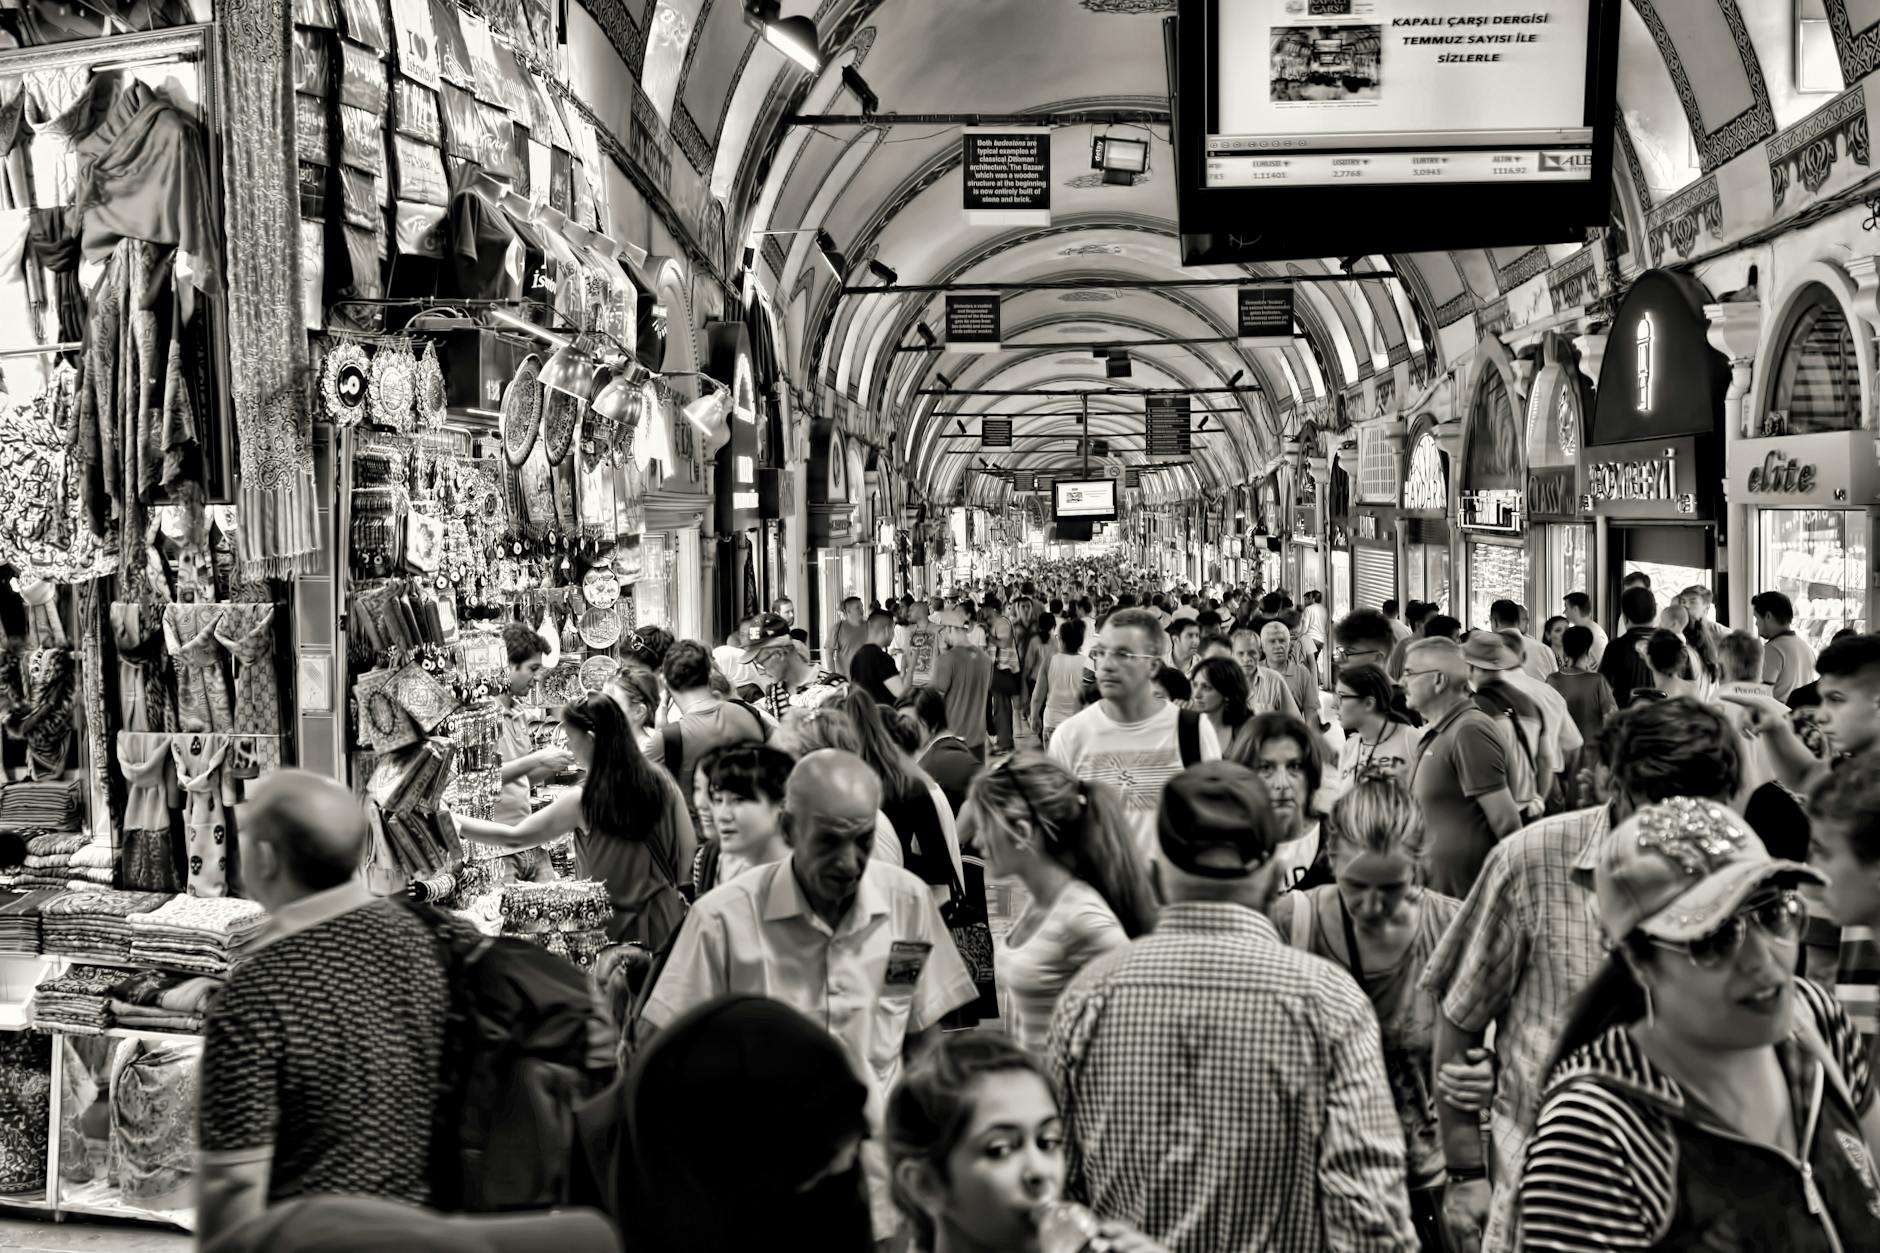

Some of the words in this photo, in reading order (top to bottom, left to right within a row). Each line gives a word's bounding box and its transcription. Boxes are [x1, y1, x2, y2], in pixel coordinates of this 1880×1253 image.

[1391, 17, 1443, 27] KAPALI
[1447, 16, 1488, 27] ÇARŞI
[1492, 13, 1549, 24] DERGİSİ
[1402, 35, 1463, 45] TEMMUZ
[1467, 34, 1511, 44] SAYISI
[1515, 32, 1537, 43] İLE
[1437, 53, 1501, 63] SİZLERLE
[977, 139, 992, 147] Both
[977, 147, 998, 156] typical
[999, 147, 1029, 156] examples
[1030, 147, 1037, 155] of
[979, 155, 1006, 163] classical
[1007, 155, 1034, 163] Ottoman
[969, 163, 1009, 171] architecture.
[1010, 163, 1022, 171] The
[1022, 163, 1044, 171] Bazaar
[1015, 180, 1047, 188] beginning
[994, 188, 1018, 196] entirely
[1528, 474, 1566, 515] CLASSY
